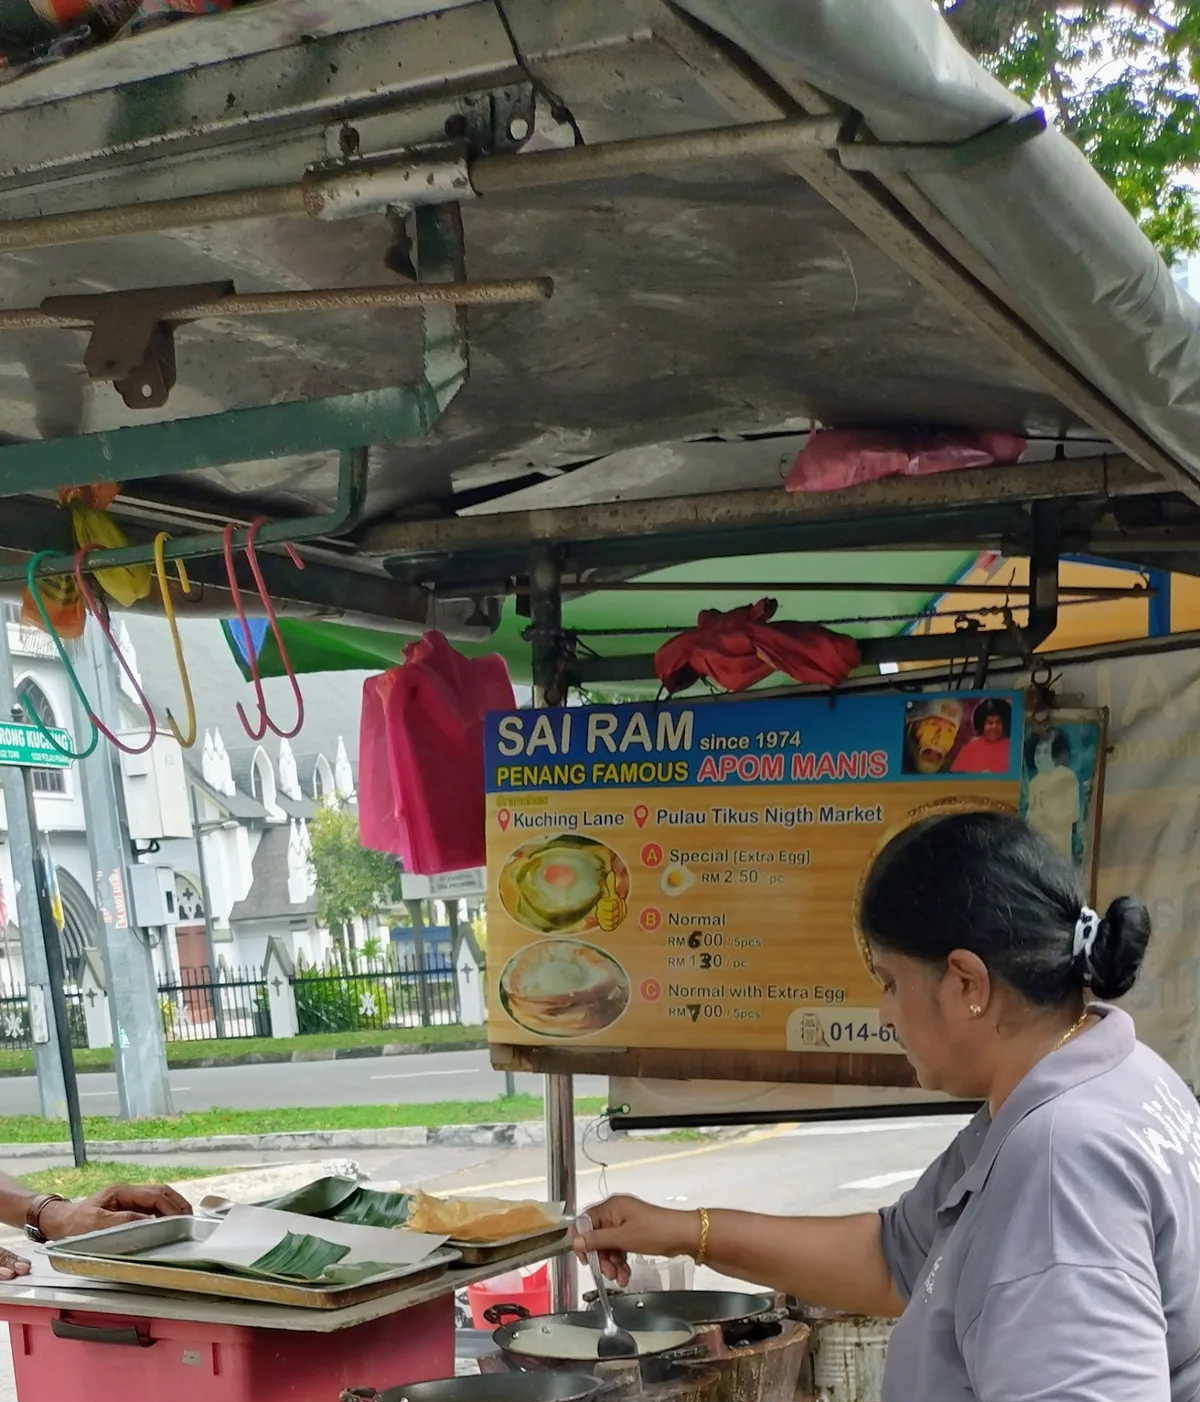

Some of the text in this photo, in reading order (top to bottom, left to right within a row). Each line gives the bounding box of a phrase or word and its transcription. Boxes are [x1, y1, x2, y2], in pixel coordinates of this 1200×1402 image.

[498, 711, 801, 756] SAI RAM since 1974
[496, 750, 888, 787] PENANG FAMOUS APOM MANIS
[514, 811, 625, 830] Kuching Lane
[656, 804, 883, 827] Pulau Tikus Nigth Market
[669, 849, 729, 866] Special
[701, 873, 720, 884] RM
[724, 870, 758, 884] 2.50
[669, 913, 726, 926] Normal
[668, 957, 685, 967] RM
[669, 984, 724, 998] Normal
[730, 984, 762, 998] with
[768, 985, 808, 999] Extra
[814, 986, 845, 1003] Egg
